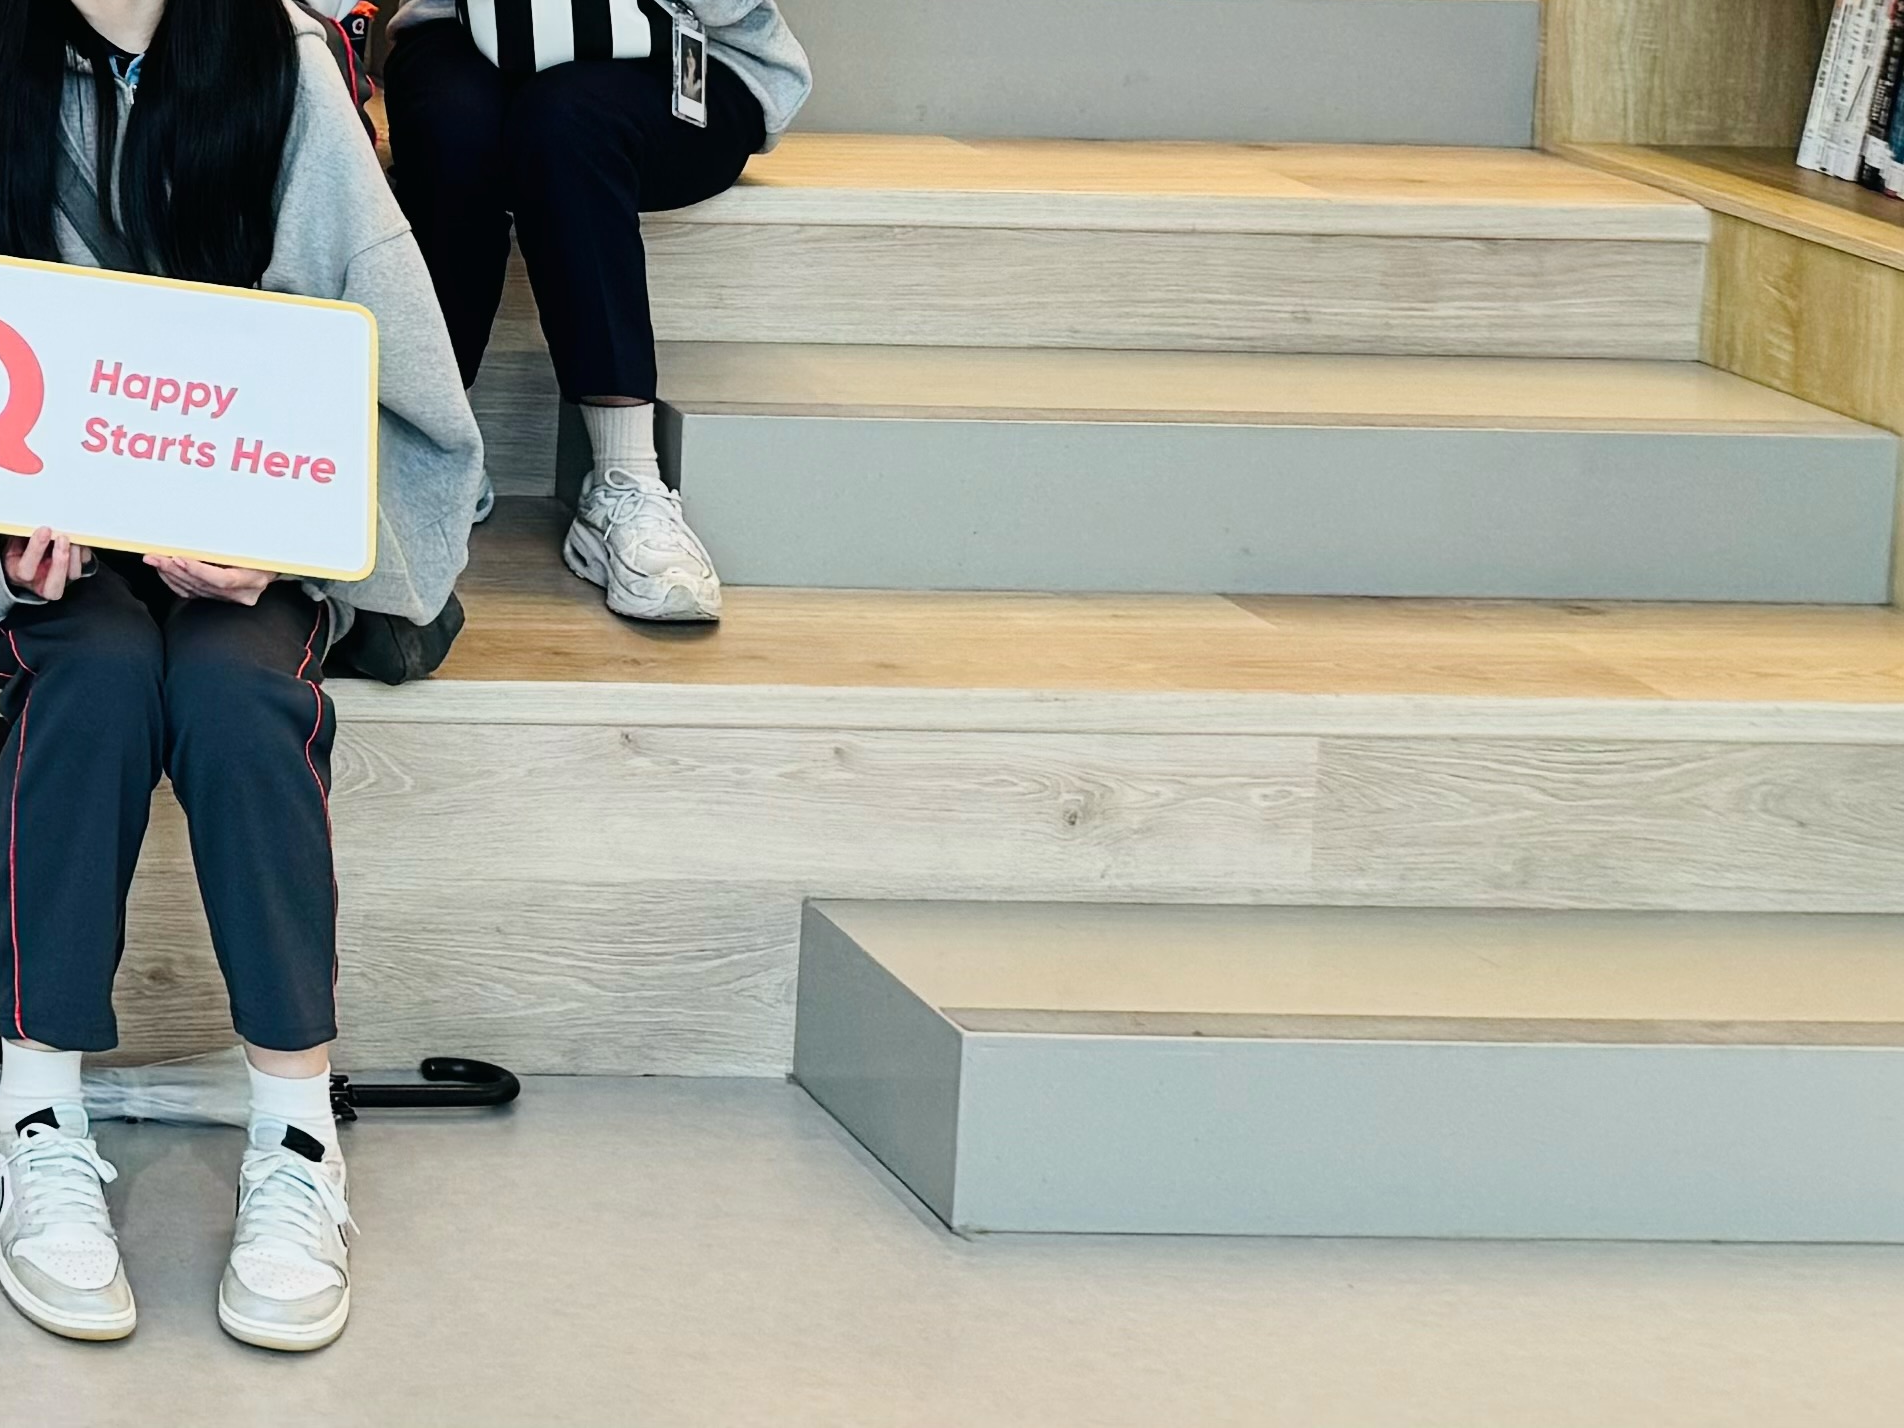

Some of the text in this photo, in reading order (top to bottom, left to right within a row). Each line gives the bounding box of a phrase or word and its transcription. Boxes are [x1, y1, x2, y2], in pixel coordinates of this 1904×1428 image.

[89, 358, 239, 420] Happy
[80, 416, 338, 485] Starts Here
